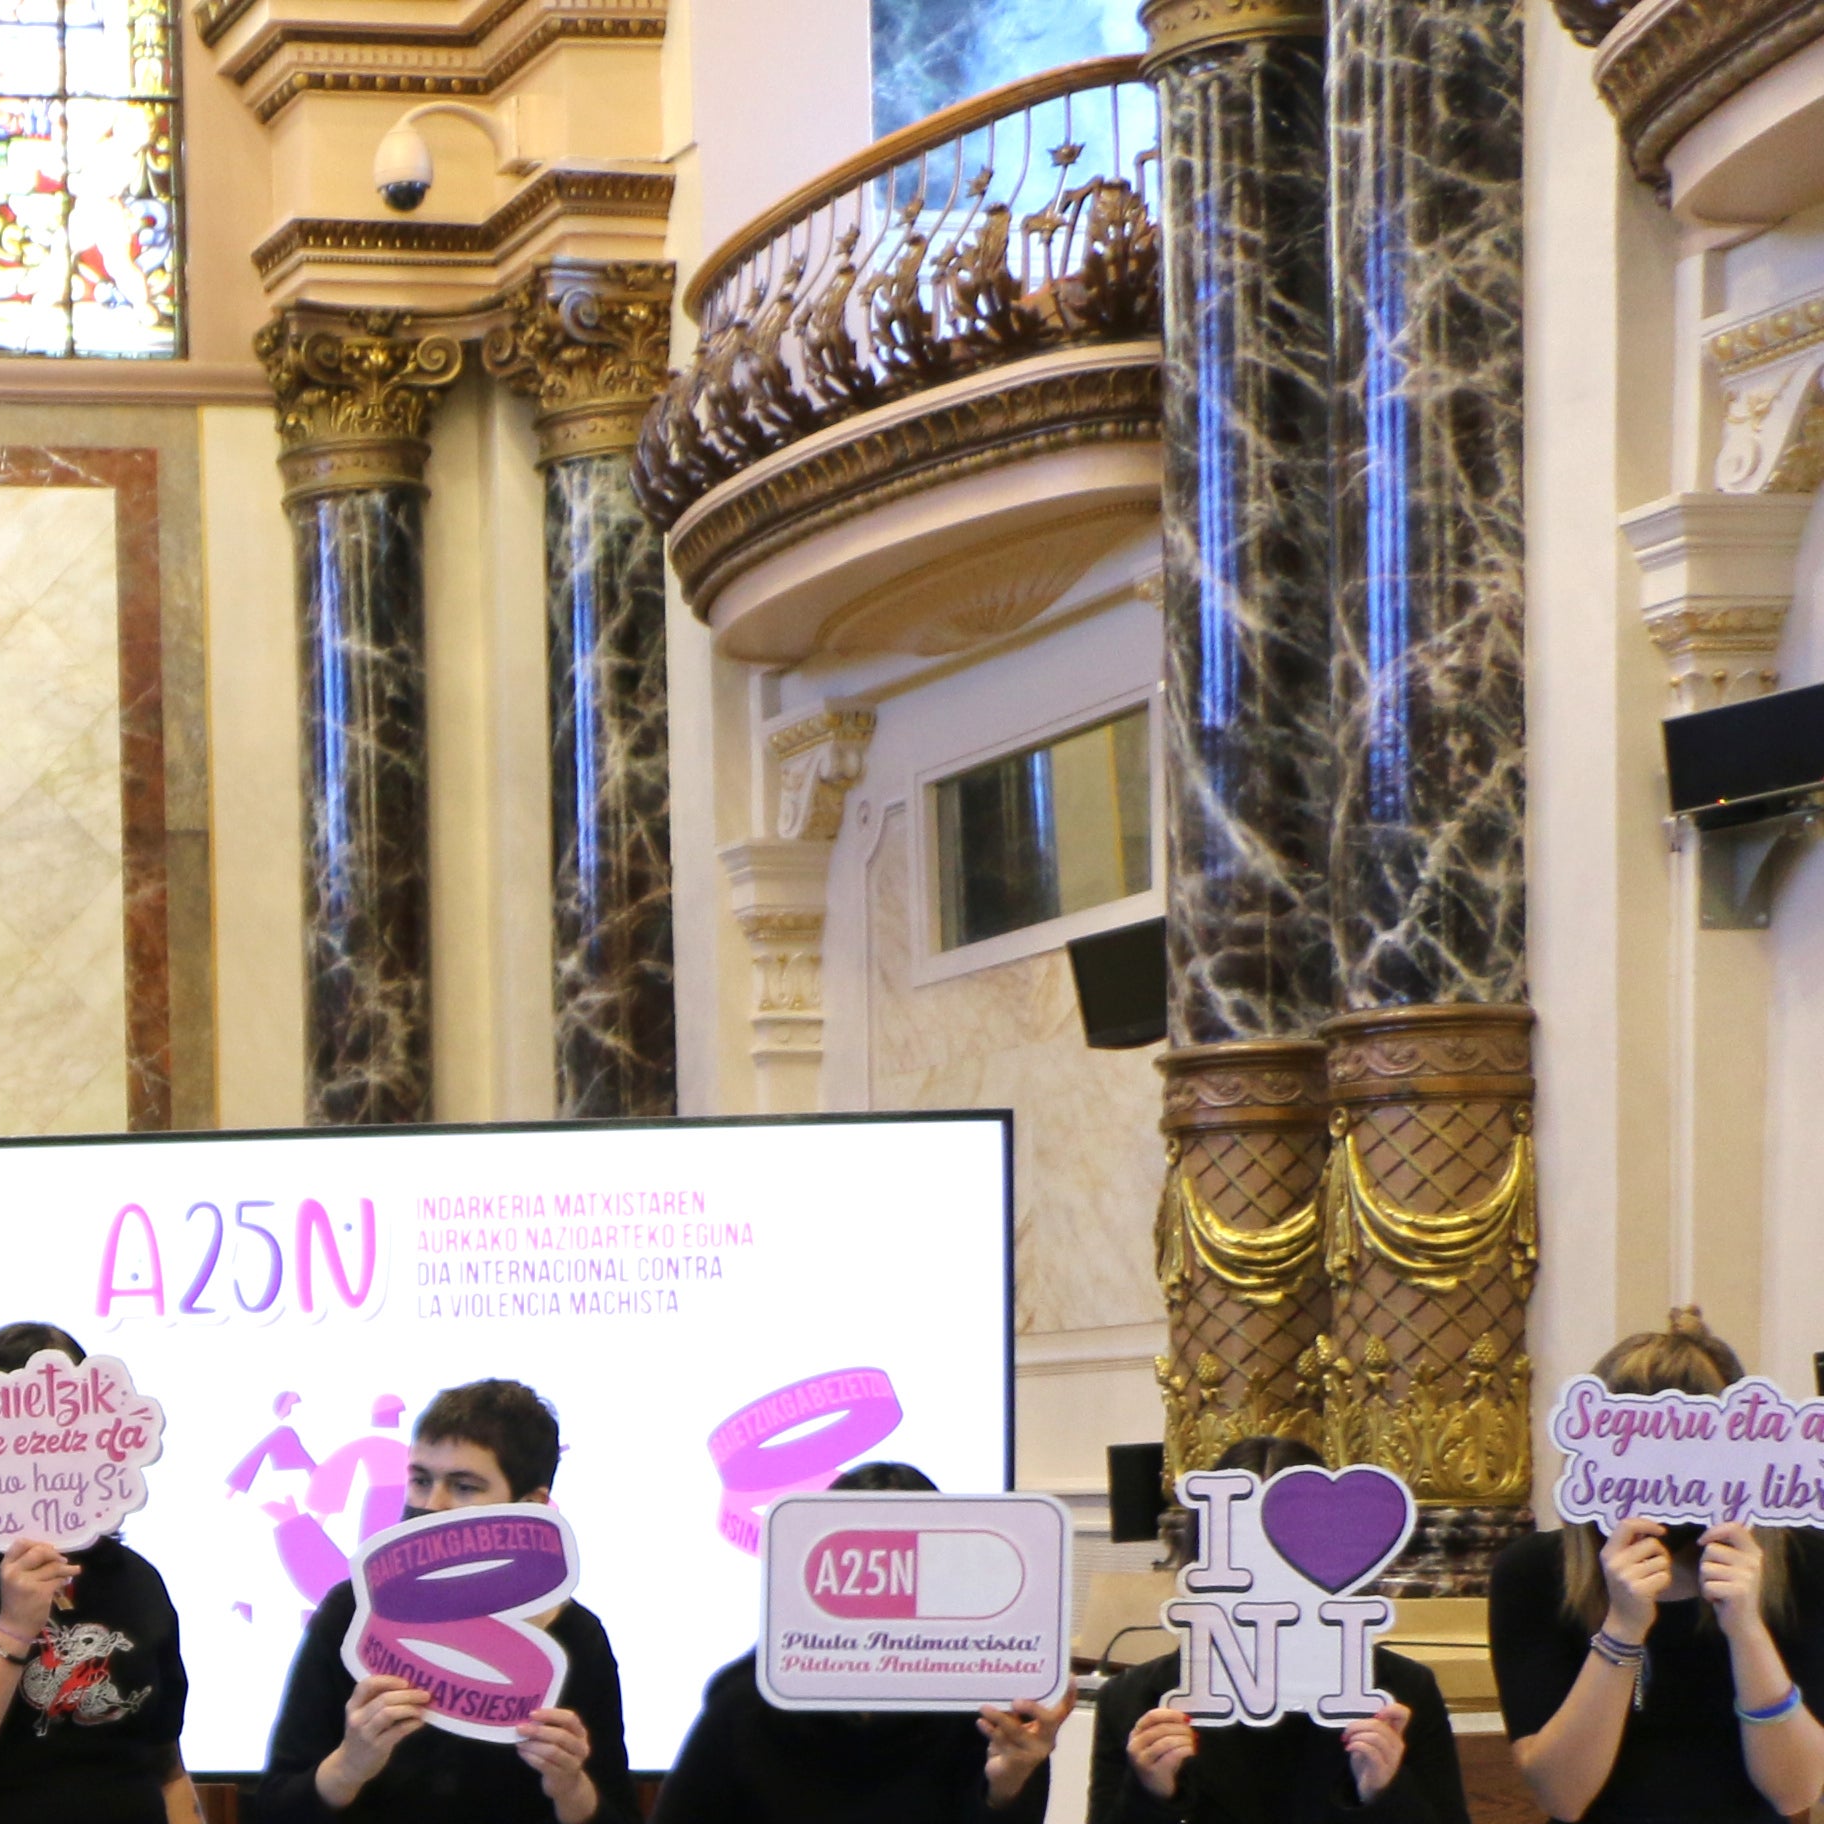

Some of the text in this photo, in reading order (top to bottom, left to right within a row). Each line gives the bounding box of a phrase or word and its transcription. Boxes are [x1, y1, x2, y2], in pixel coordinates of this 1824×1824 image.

[417, 1190, 705, 1221] INDARKERIA MATXISTAREN
[94, 1198, 377, 1318] A25N
[417, 1222, 753, 1254] AURKAKO NAZIOARTEKO EGUNA
[418, 1256, 723, 1286] DIA INTERNACIONAL CONTRA
[418, 1289, 679, 1319] LA VIOLENCIA MACHISTA
[13, 1428, 88, 1455] ezetz
[95, 1417, 147, 1462] da
[1565, 1390, 1716, 1456] Seguru
[1728, 1393, 1791, 1442] eta
[33, 1461, 89, 1507] hay
[1572, 1460, 1713, 1521] Segura
[1721, 1480, 1751, 1522] y
[32, 1498, 87, 1534] No
[1186, 1475, 1253, 1593] I
[813, 1547, 916, 1597] A25N
[781, 1630, 1041, 1651] Pilula Antimatxista!
[1167, 1601, 1387, 1720] NI
[875, 1654, 1045, 1674] Antimachista!
